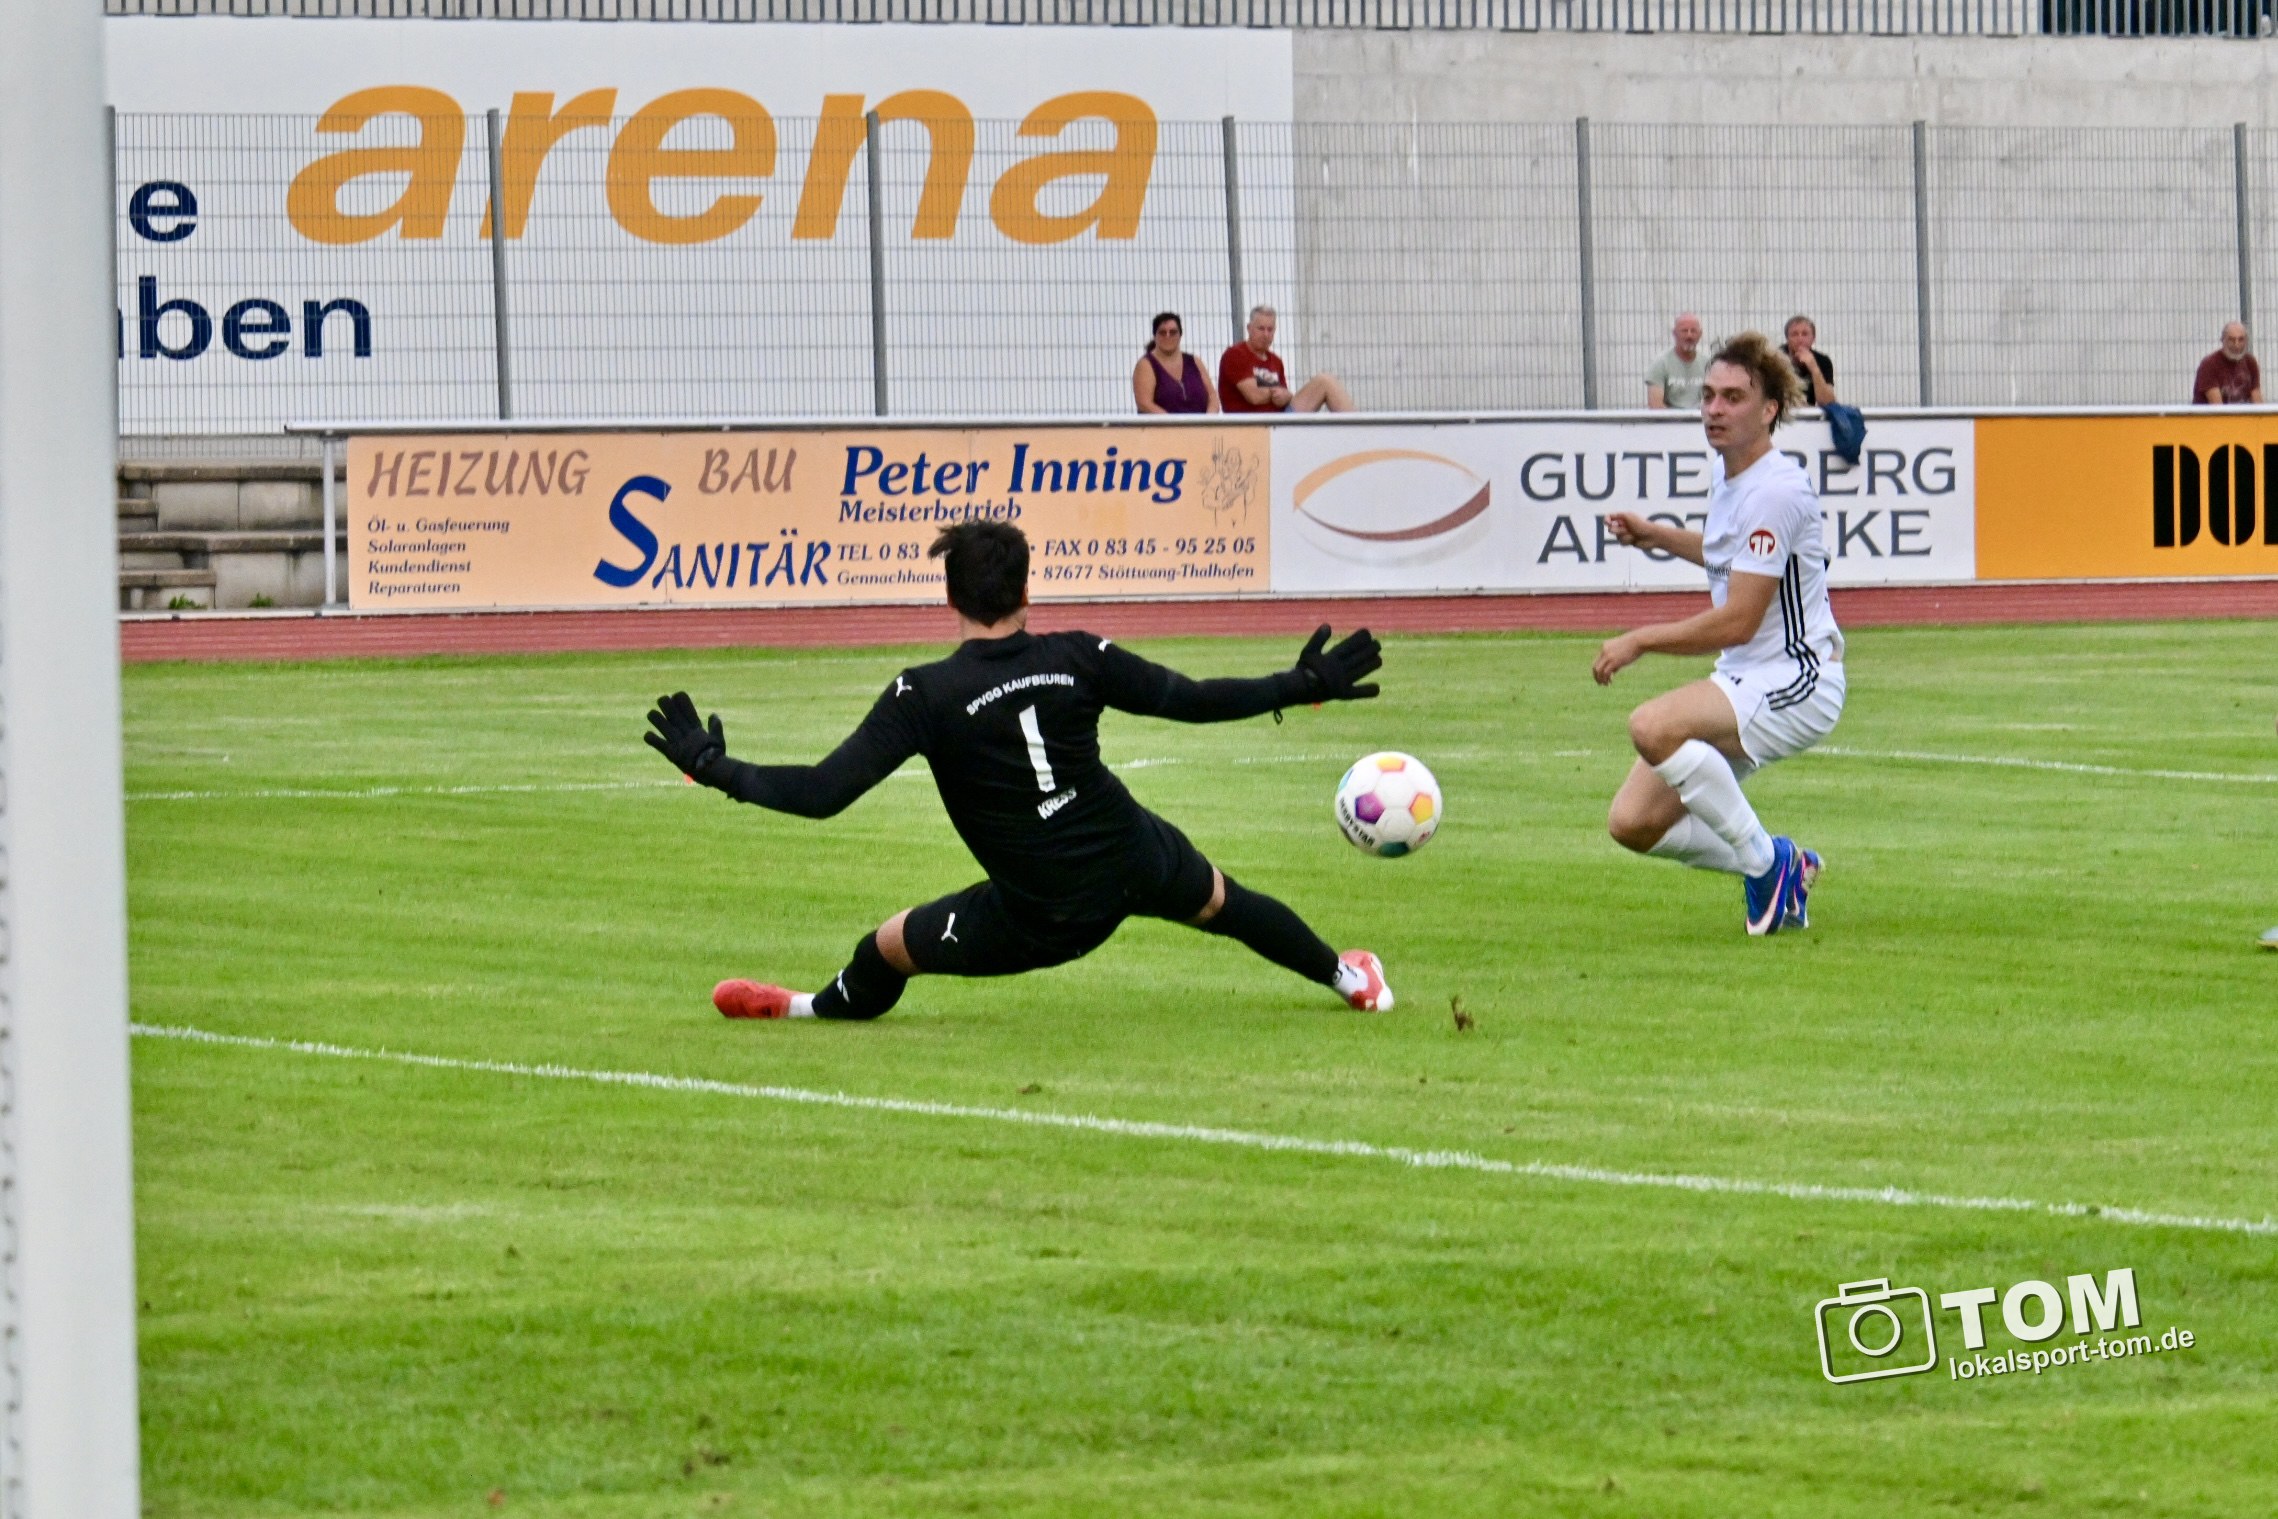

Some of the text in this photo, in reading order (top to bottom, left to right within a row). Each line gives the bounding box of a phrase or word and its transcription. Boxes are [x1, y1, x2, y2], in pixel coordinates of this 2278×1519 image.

[287, 84, 1157, 245] arena
[367, 448, 591, 498] HEIZUNG
[698, 448, 797, 494] BAU
[840, 443, 1187, 503] Peter Inning
[1520, 446, 1956, 501] GUTEERG
[416, 517, 511, 534] Gasfeuerung
[838, 496, 1023, 523] Meisterbetrieb
[368, 539, 467, 555] Solaranlagen
[837, 543, 873, 561] TEL
[897, 542, 921, 560] 83
[1043, 538, 1081, 557] FAX
[1086, 538, 1099, 556] 0
[1105, 538, 1128, 556] 83
[1133, 537, 1157, 555] 45
[1175, 537, 1198, 555] 95
[1203, 536, 1227, 554] 25
[1232, 536, 1256, 554] 05
[368, 559, 471, 574] Kundendienst
[1043, 565, 1094, 581] 87677
[1098, 562, 1255, 582] Stöttwang-Thalhofen
[369, 580, 461, 597] Reparaturen
[966, 673, 1075, 716] SPVGG KAUFBEUREN
[1018, 704, 1057, 793] 1
